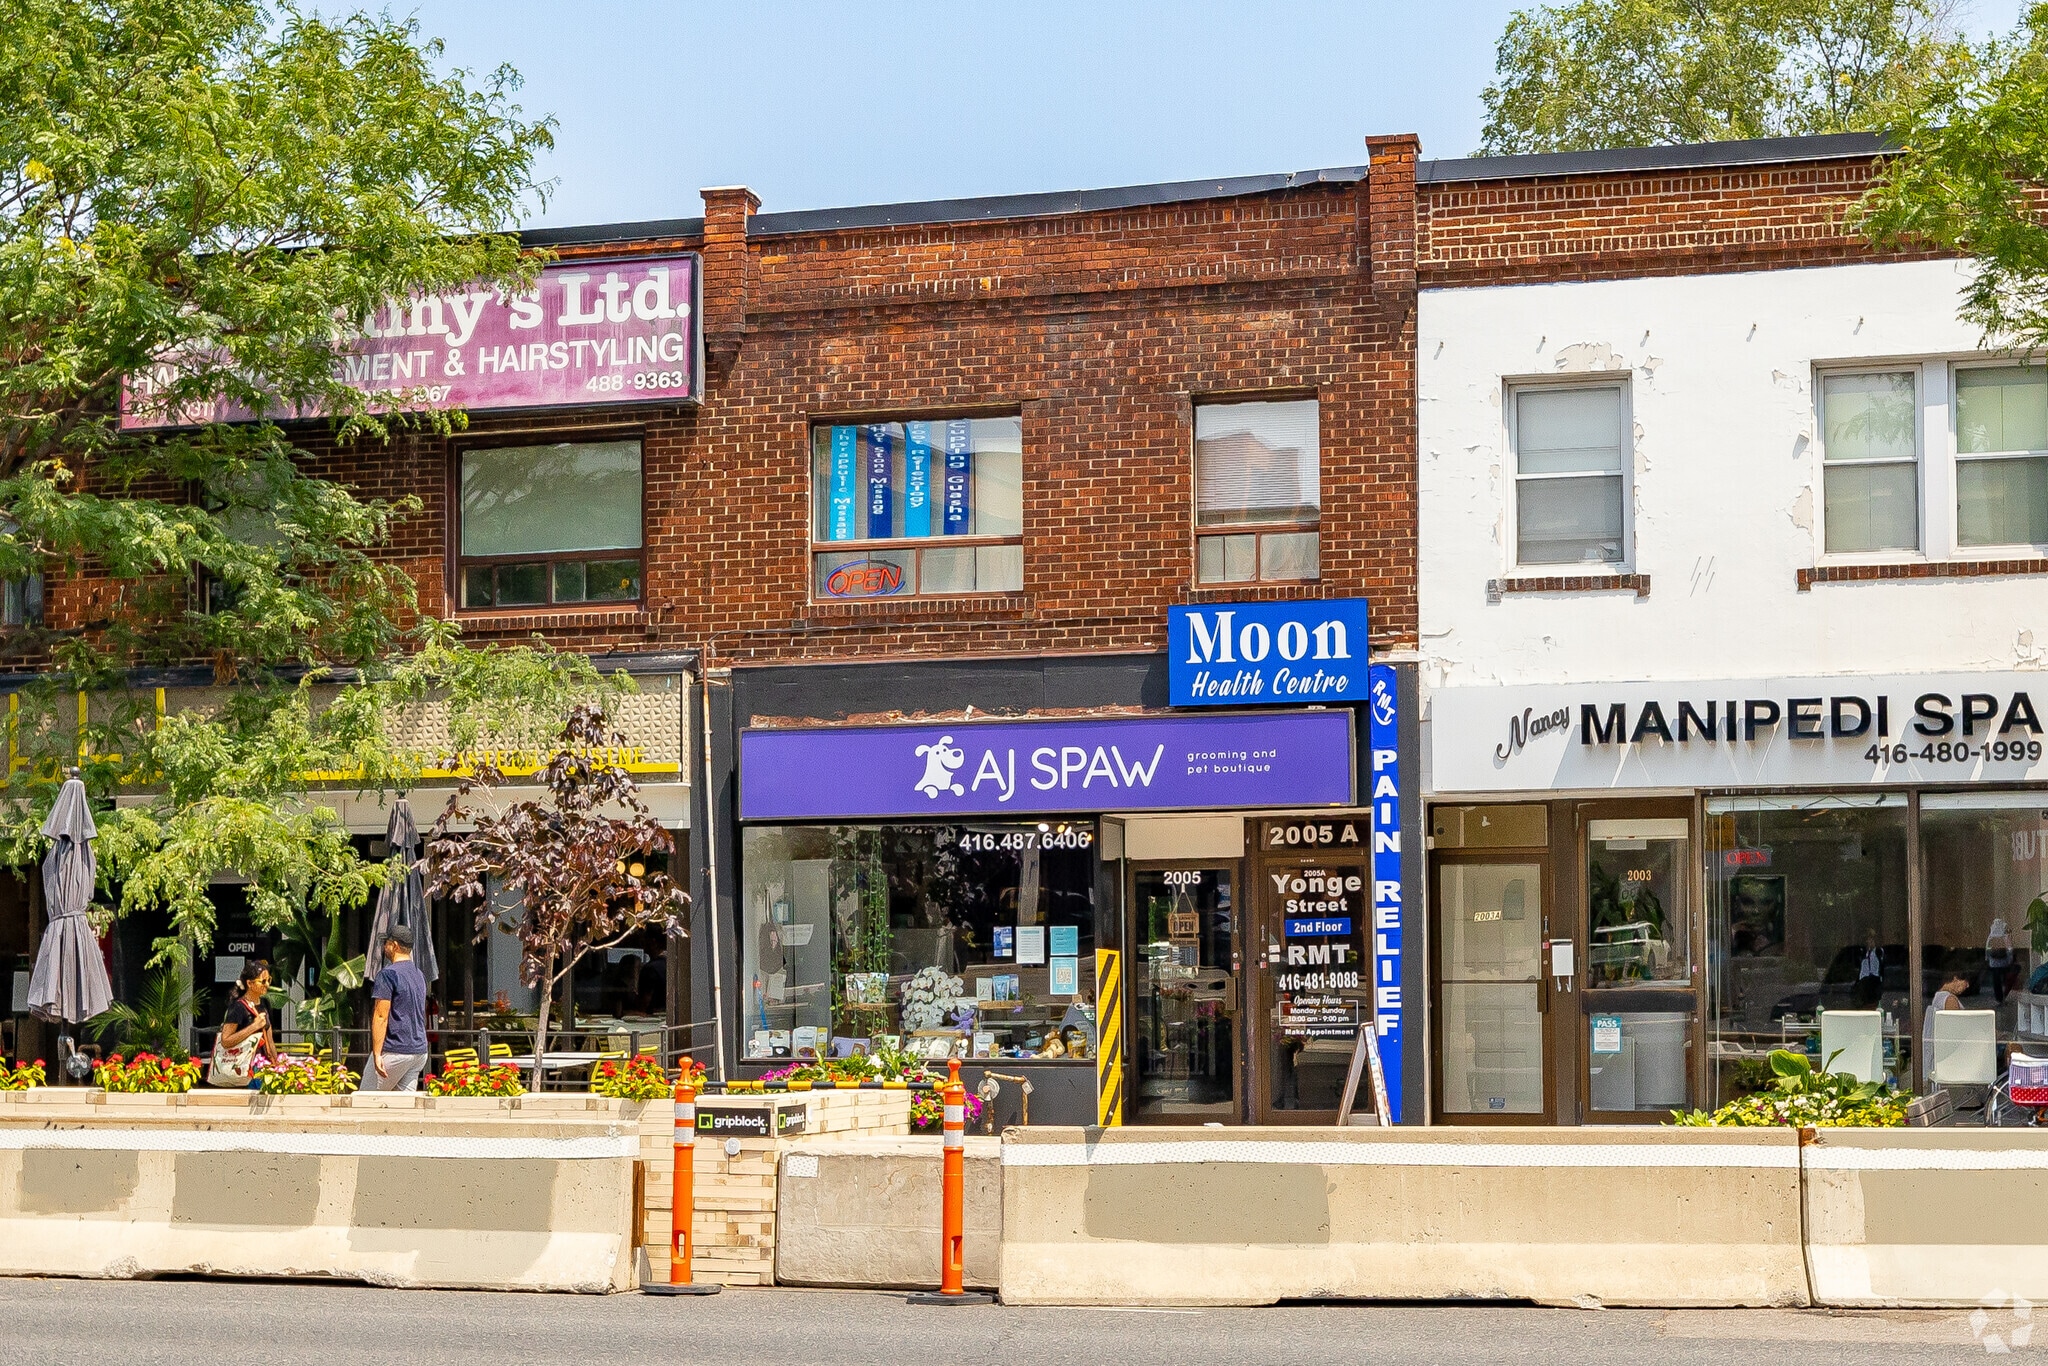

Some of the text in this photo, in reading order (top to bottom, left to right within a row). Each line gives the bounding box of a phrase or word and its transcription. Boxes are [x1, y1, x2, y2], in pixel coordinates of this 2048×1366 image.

[558, 266, 691, 326] Ltd.
[443, 348, 466, 377] &
[478, 332, 684, 374] HAIRSTYLING
[873, 446, 885, 474] Stone
[947, 475, 965, 521] Guasha
[828, 566, 901, 594] OPEN
[1185, 611, 1352, 664] Moon
[1191, 667, 1349, 698] Health Centre
[1372, 680, 1396, 722] RMT
[1496, 691, 2044, 761] Nancy MANIPEDI SPA
[1187, 749, 1276, 762] grooming and
[1864, 740, 2042, 764] 416-480-1999
[971, 743, 1165, 802] AJ SPAW
[1187, 763, 1271, 776] pet boutique
[959, 831, 1089, 851] 416.487.6406
[1269, 824, 1359, 845] 2005 A
[1726, 851, 1767, 865] OPEN
[1163, 871, 1201, 885] 2005
[1303, 869, 1326, 877] 2005A
[1627, 870, 1652, 881] 2003
[1271, 873, 1361, 897] Yonge
[1373, 750, 1402, 1036] PAIN RELIEF
[1286, 898, 1348, 913] Street
[1294, 922, 1343, 933] 2nd Floor
[228, 943, 255, 952] OPEN
[1287, 944, 1351, 966] RMT
[1279, 971, 1358, 991] 416-481-8088
[1293, 994, 1342, 1006] Opening Hours
[1290, 1007, 1317, 1015] Monday
[1321, 1007, 1346, 1015] Sunday
[1285, 1028, 1354, 1037] Make Appointment
[1597, 1020, 1617, 1028] PASS
